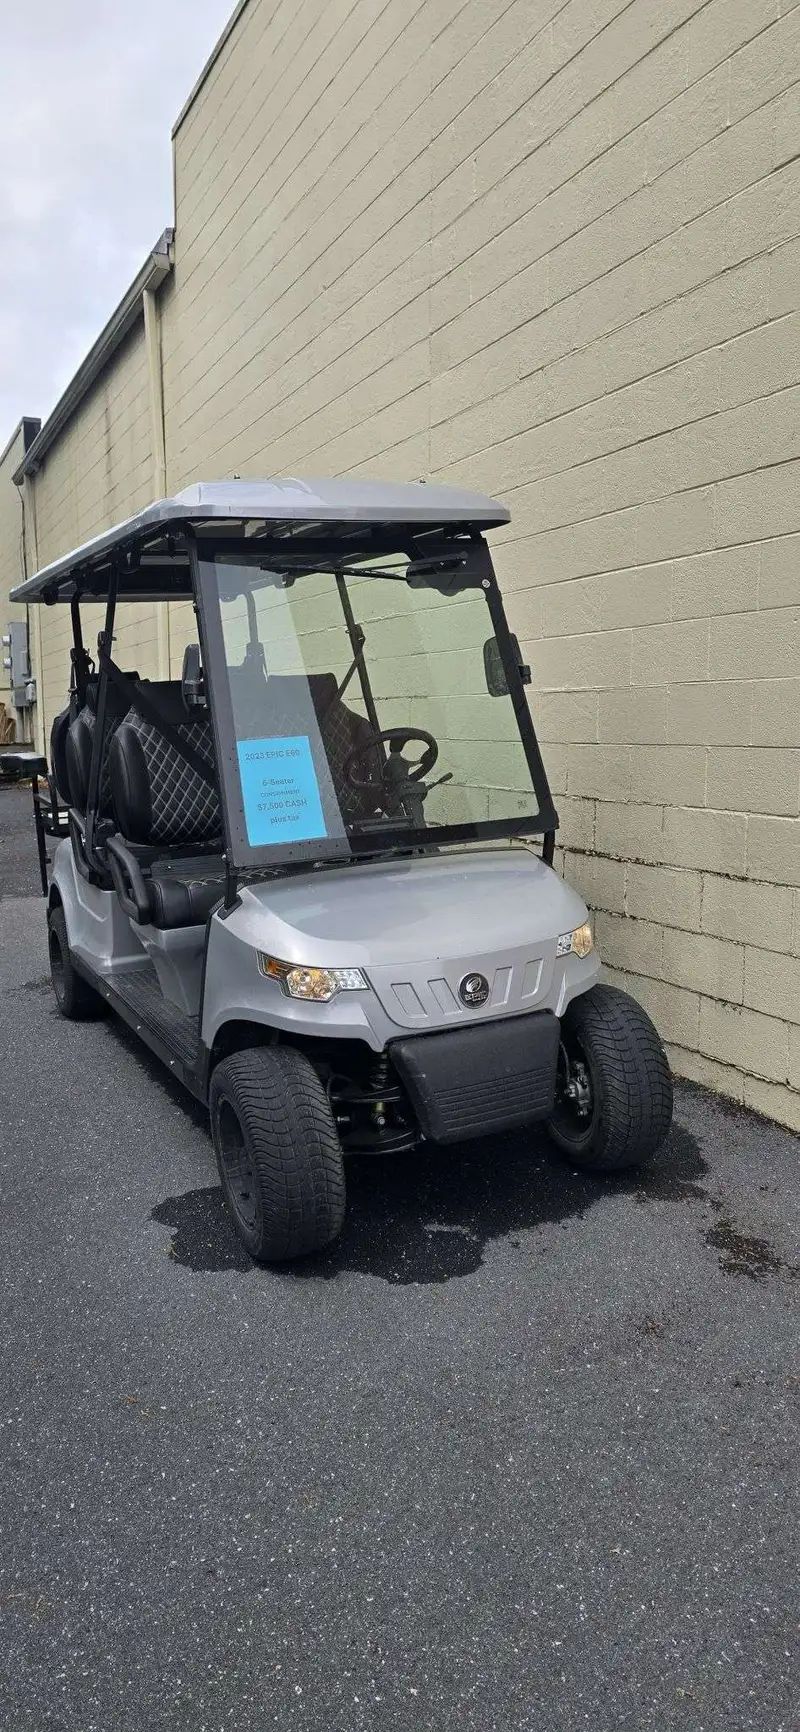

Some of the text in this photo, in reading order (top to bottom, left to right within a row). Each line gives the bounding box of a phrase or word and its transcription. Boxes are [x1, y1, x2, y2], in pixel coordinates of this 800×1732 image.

[245, 749, 300, 761] 2023 EPIC E60
[262, 778, 294, 787] 6-Seater
[285, 799, 308, 808] CASH
[270, 814, 300, 825] plus tax
